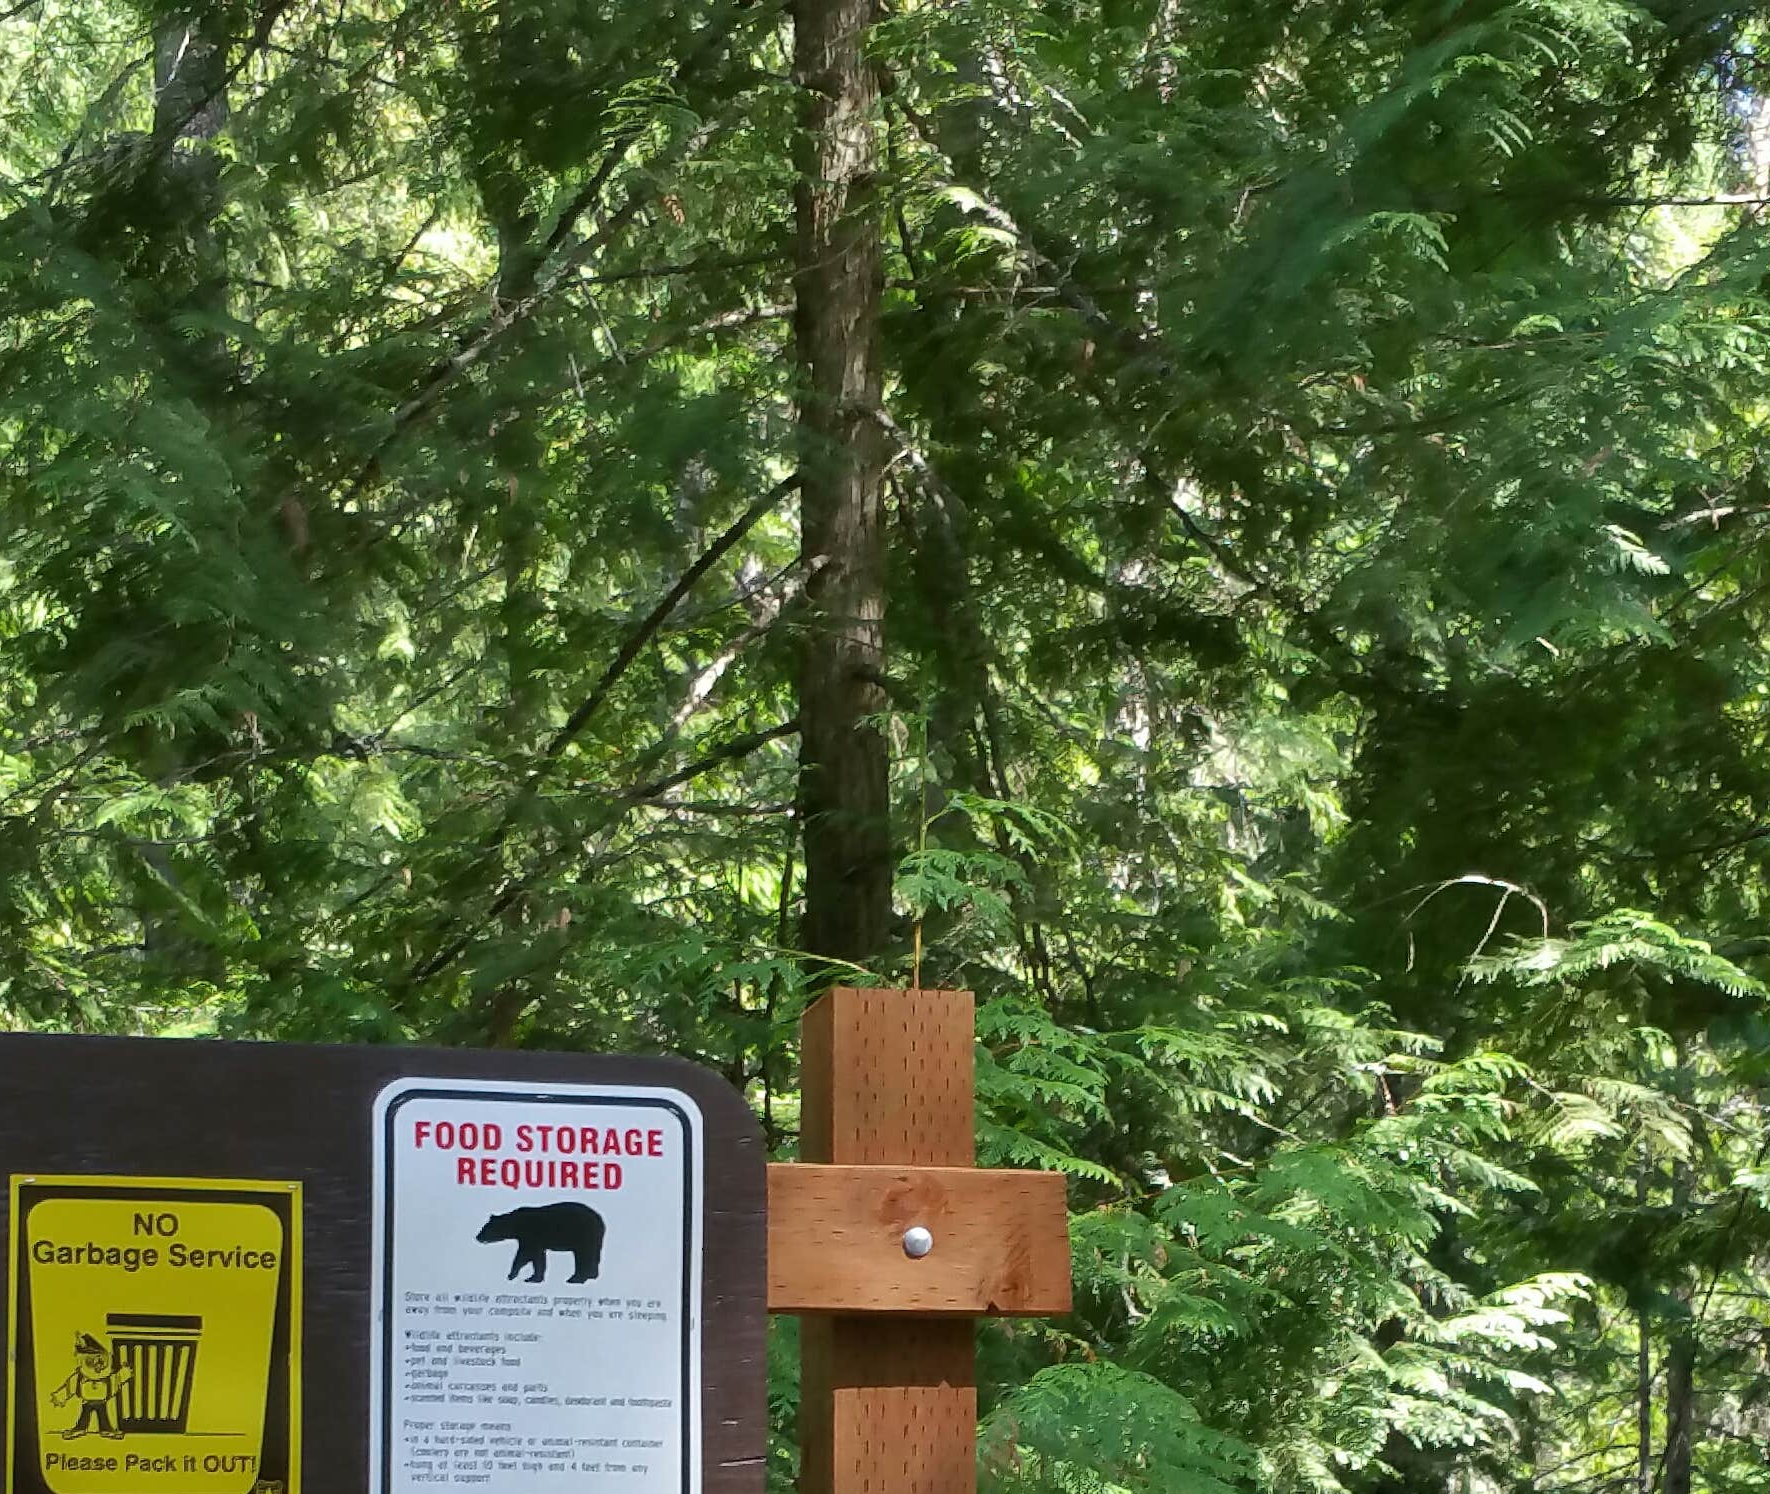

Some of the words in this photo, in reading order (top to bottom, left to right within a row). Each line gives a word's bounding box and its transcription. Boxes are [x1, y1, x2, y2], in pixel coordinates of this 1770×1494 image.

[415, 1121, 502, 1151] FOOD
[517, 1125, 664, 1156] STORAGE
[457, 1158, 623, 1190] REQUIRED
[134, 1213, 179, 1237] NO
[33, 1240, 158, 1272] Garbage
[169, 1243, 277, 1269] Service
[45, 1453, 118, 1471] Please
[125, 1454, 177, 1472] Pack
[183, 1455, 196, 1472] it
[203, 1456, 255, 1473] OUT!
